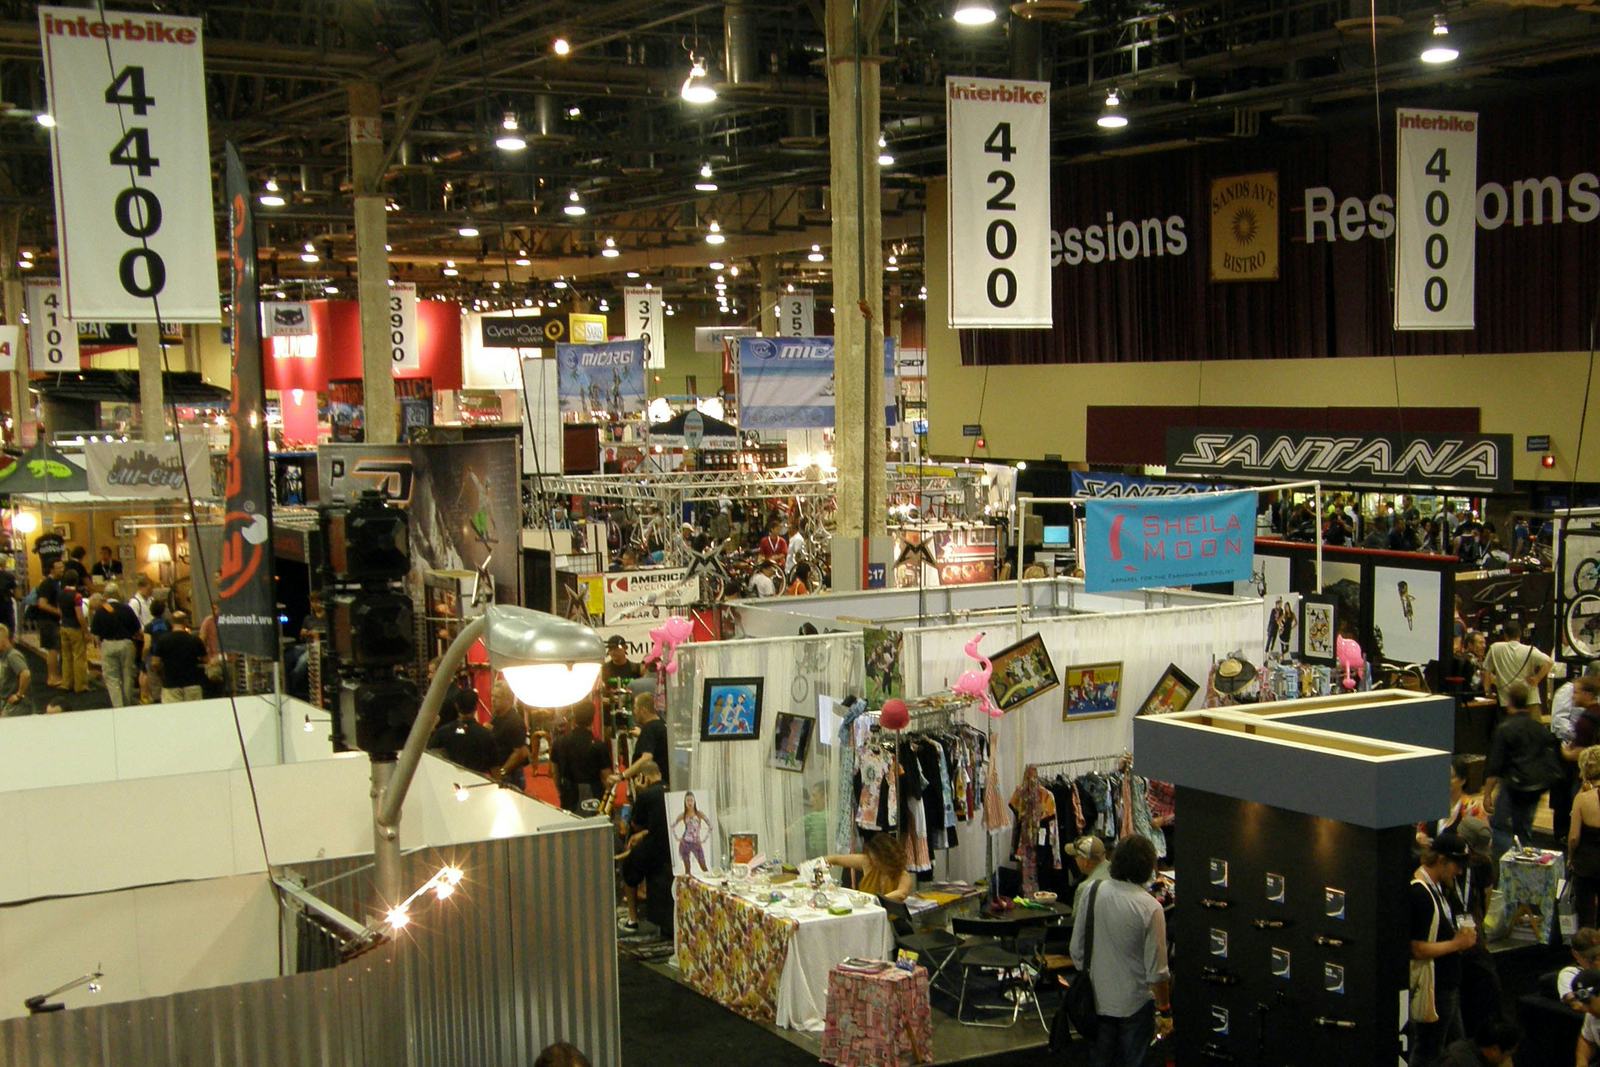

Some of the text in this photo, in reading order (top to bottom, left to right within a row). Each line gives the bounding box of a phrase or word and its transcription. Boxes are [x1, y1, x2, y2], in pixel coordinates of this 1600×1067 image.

[44, 14, 199, 45] interbike
[950, 83, 1046, 105] interbike
[1400, 113, 1476, 132] interbike
[104, 65, 167, 298] 4400
[1212, 182, 1251, 215] SANDS
[984, 122, 1018, 308] 4200
[1424, 148, 1450, 312] 4000
[1051, 212, 1188, 267] essions
[1223, 248, 1267, 273] BISTRO
[44, 293, 63, 363] 4100
[581, 350, 634, 367] MICARGI
[1175, 434, 1498, 480] SANTANA
[1142, 514, 1242, 536] SHEILA
[1143, 538, 1242, 561] MOON
